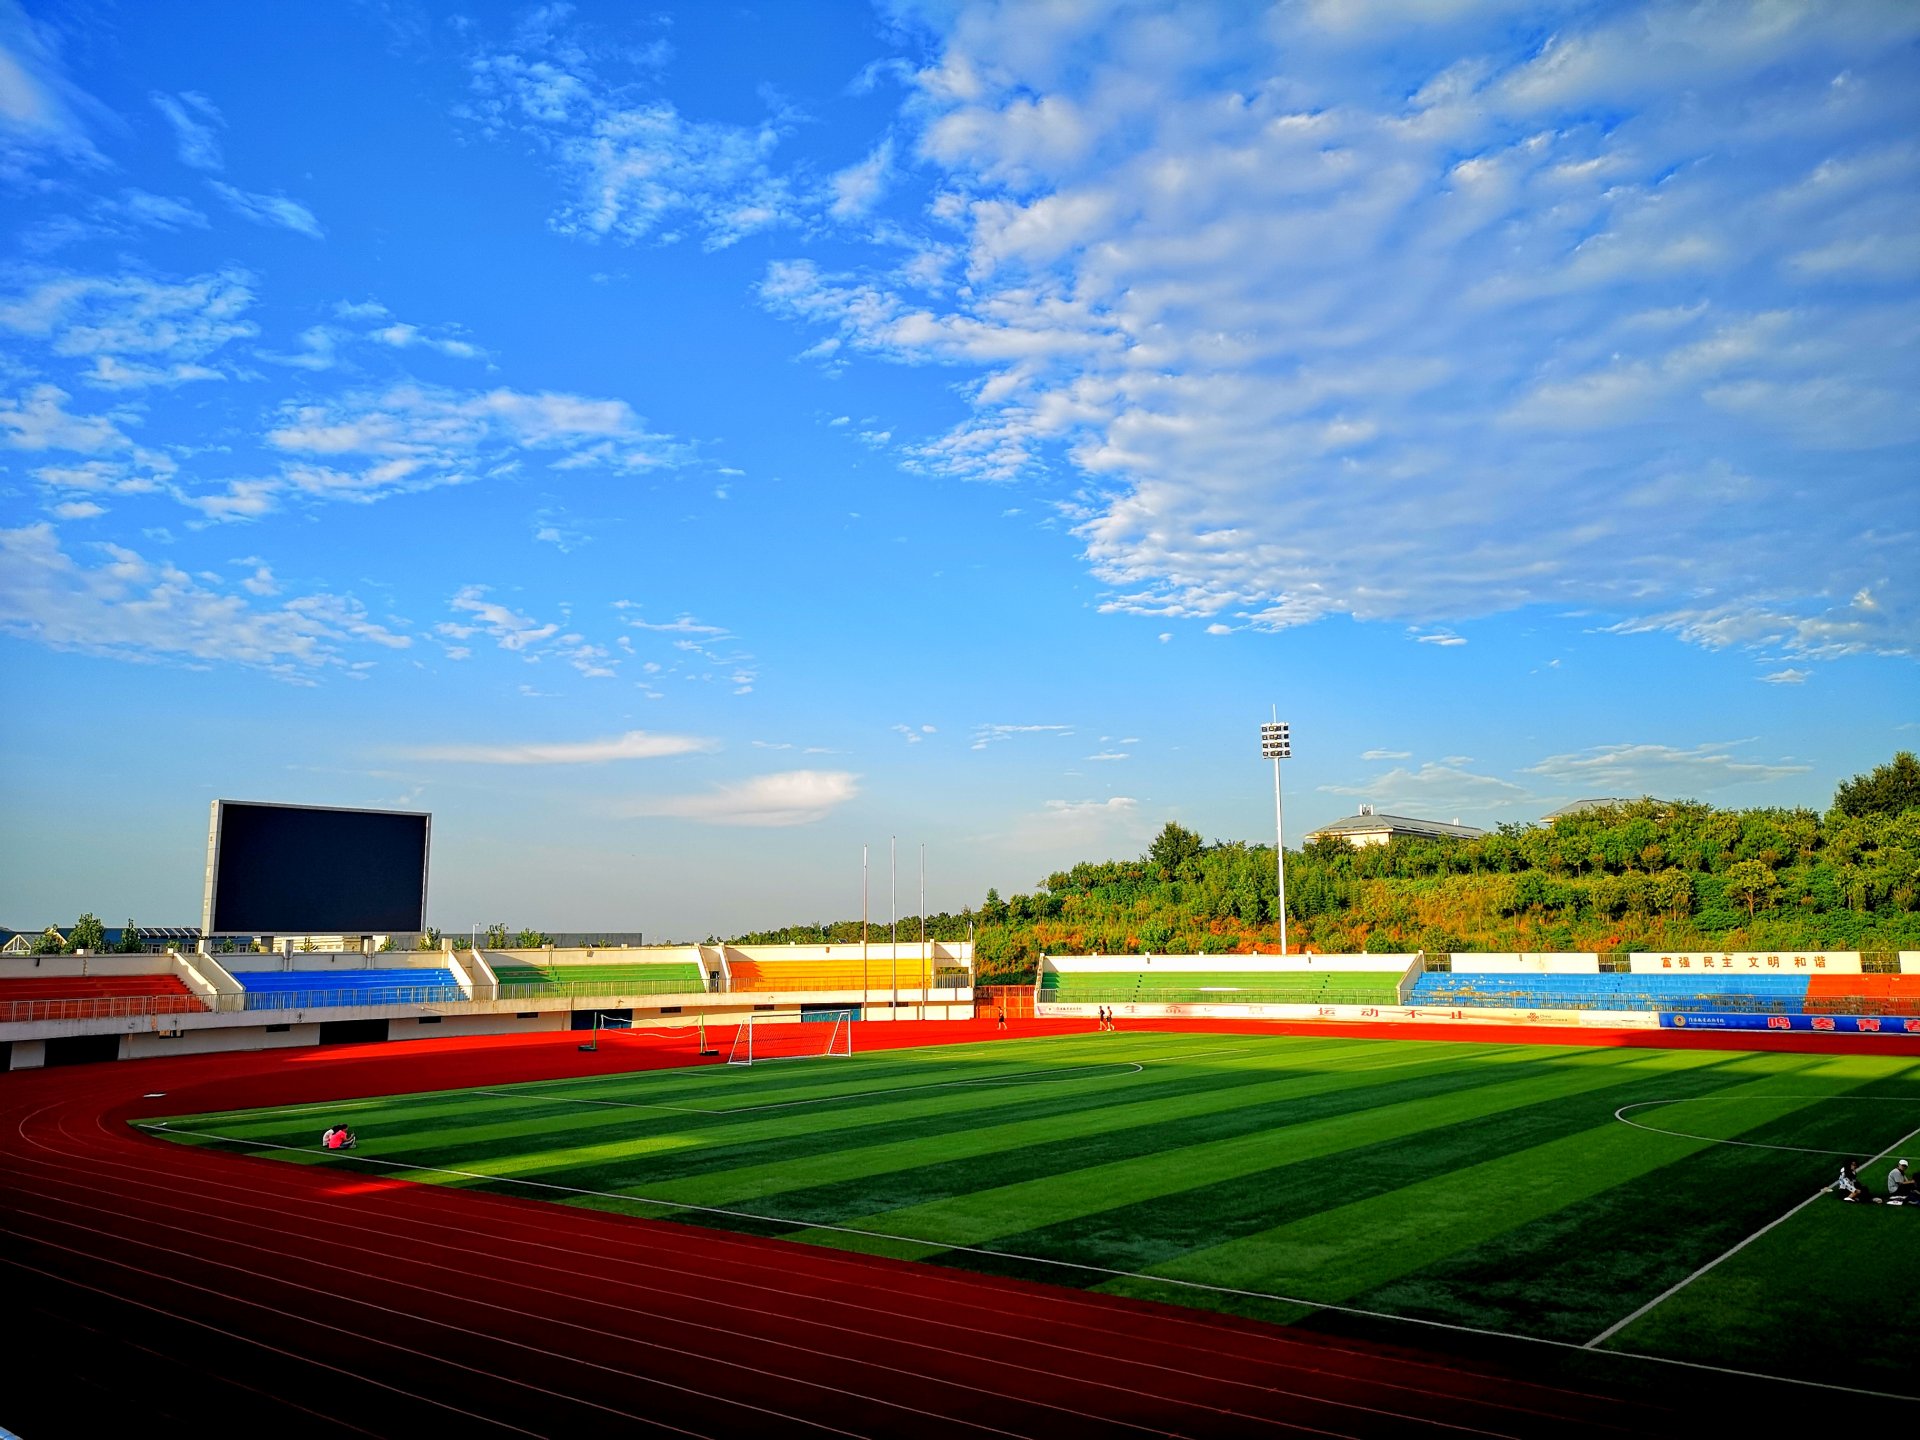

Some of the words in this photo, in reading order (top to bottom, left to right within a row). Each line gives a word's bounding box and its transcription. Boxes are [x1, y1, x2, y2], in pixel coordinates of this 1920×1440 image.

[1661, 956, 1690, 968] 富强
[1703, 956, 1733, 968] 民主
[1749, 956, 1780, 968] 文明
[1794, 956, 1826, 968] 和谐
[1317, 1007, 1468, 1020] 运动不止
